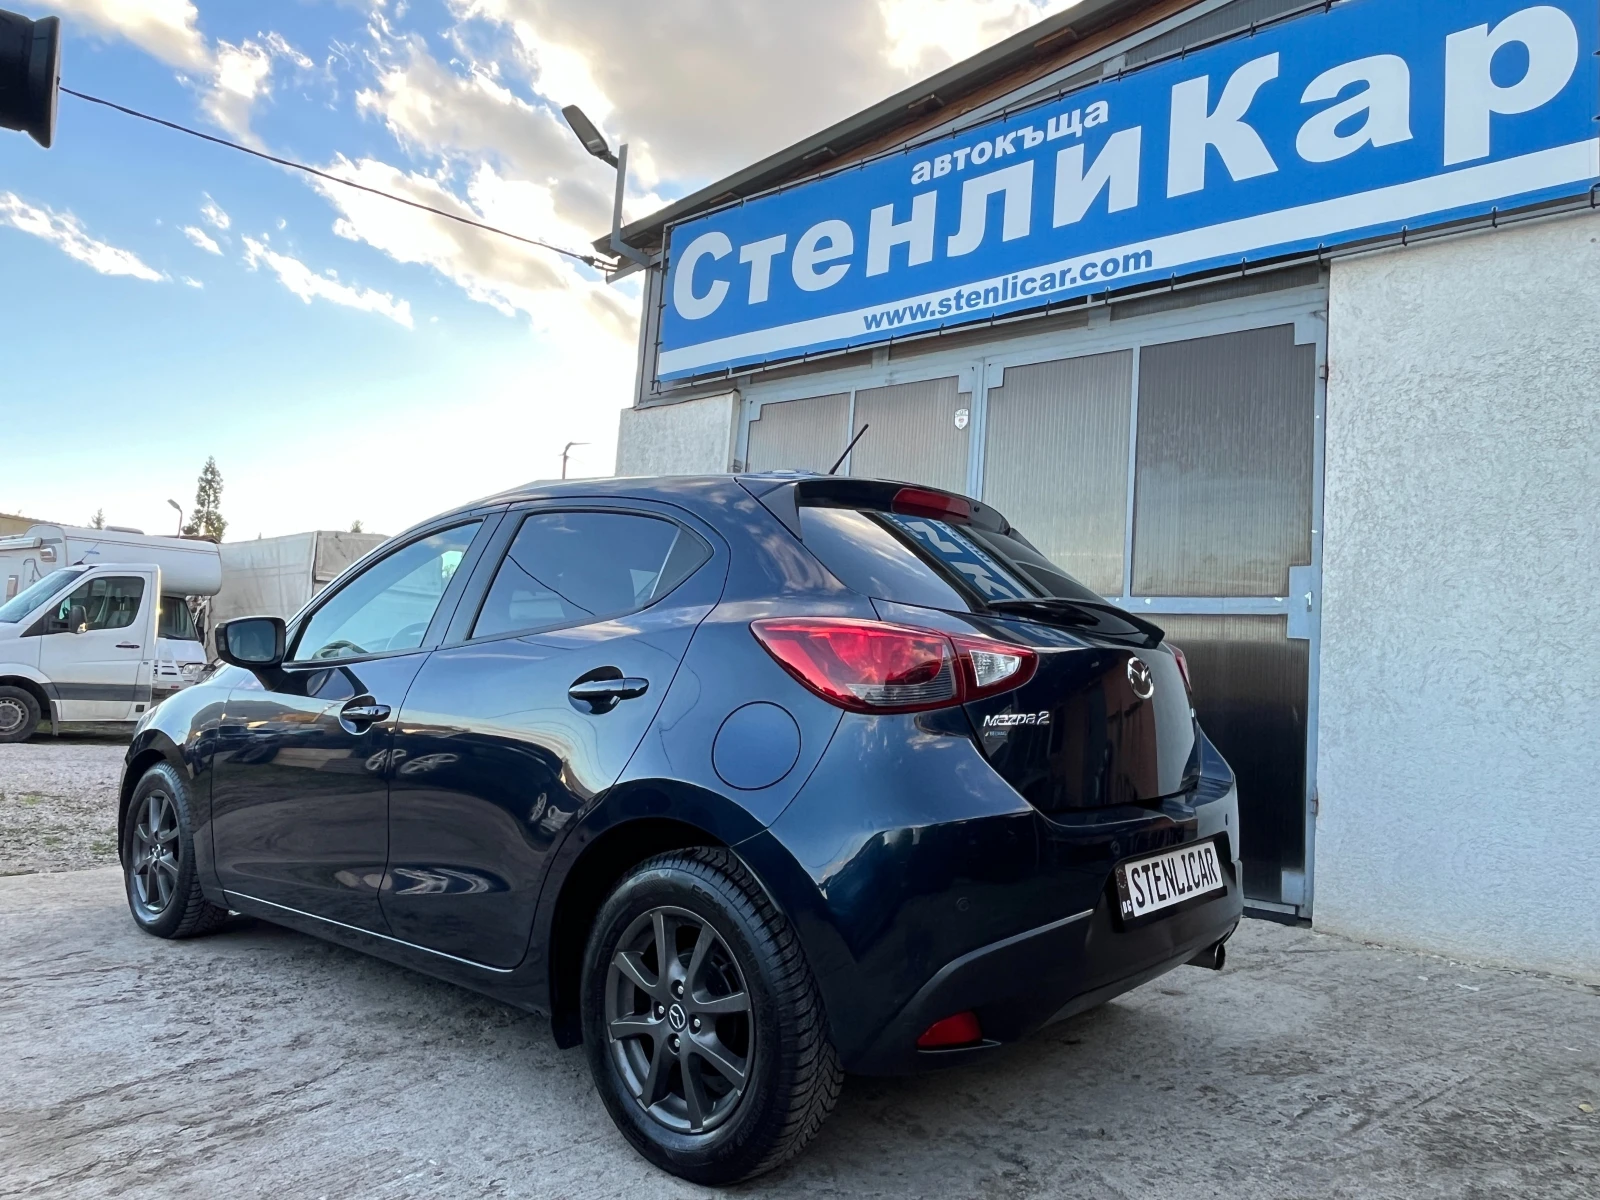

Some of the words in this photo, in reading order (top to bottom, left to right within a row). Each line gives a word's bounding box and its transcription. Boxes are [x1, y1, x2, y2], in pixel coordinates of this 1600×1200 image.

[910, 99, 1109, 186] автокъща
[863, 248, 1154, 333] www.stenlicar.com
[1130, 847, 1219, 909] STENLICAR
